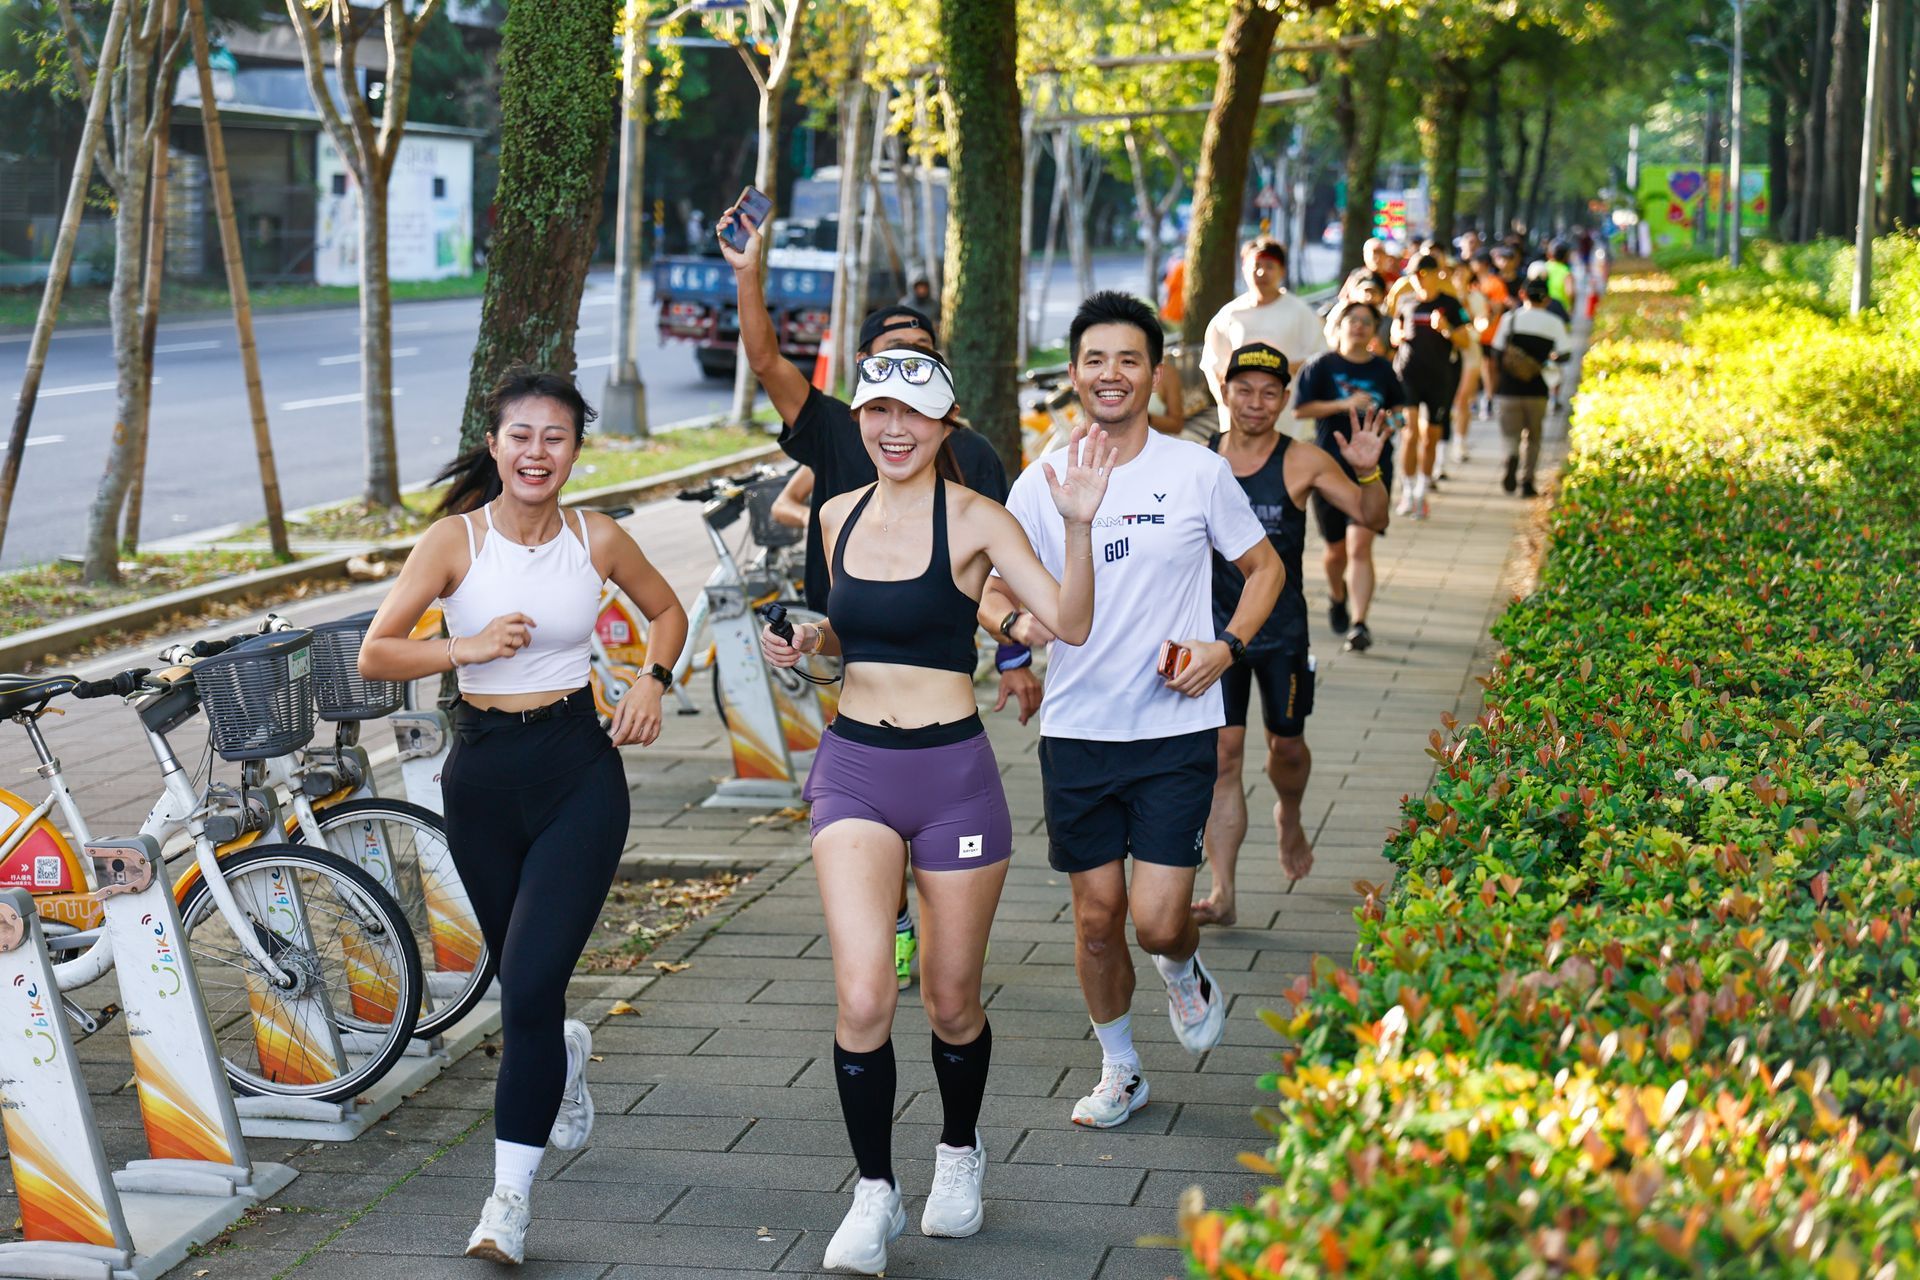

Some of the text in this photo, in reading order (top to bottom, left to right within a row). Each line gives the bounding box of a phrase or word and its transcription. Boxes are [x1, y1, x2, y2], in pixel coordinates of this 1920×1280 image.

[669, 265, 720, 290] KLP
[1091, 514, 1165, 529] AMTPE
[1104, 536, 1130, 563] GO!
